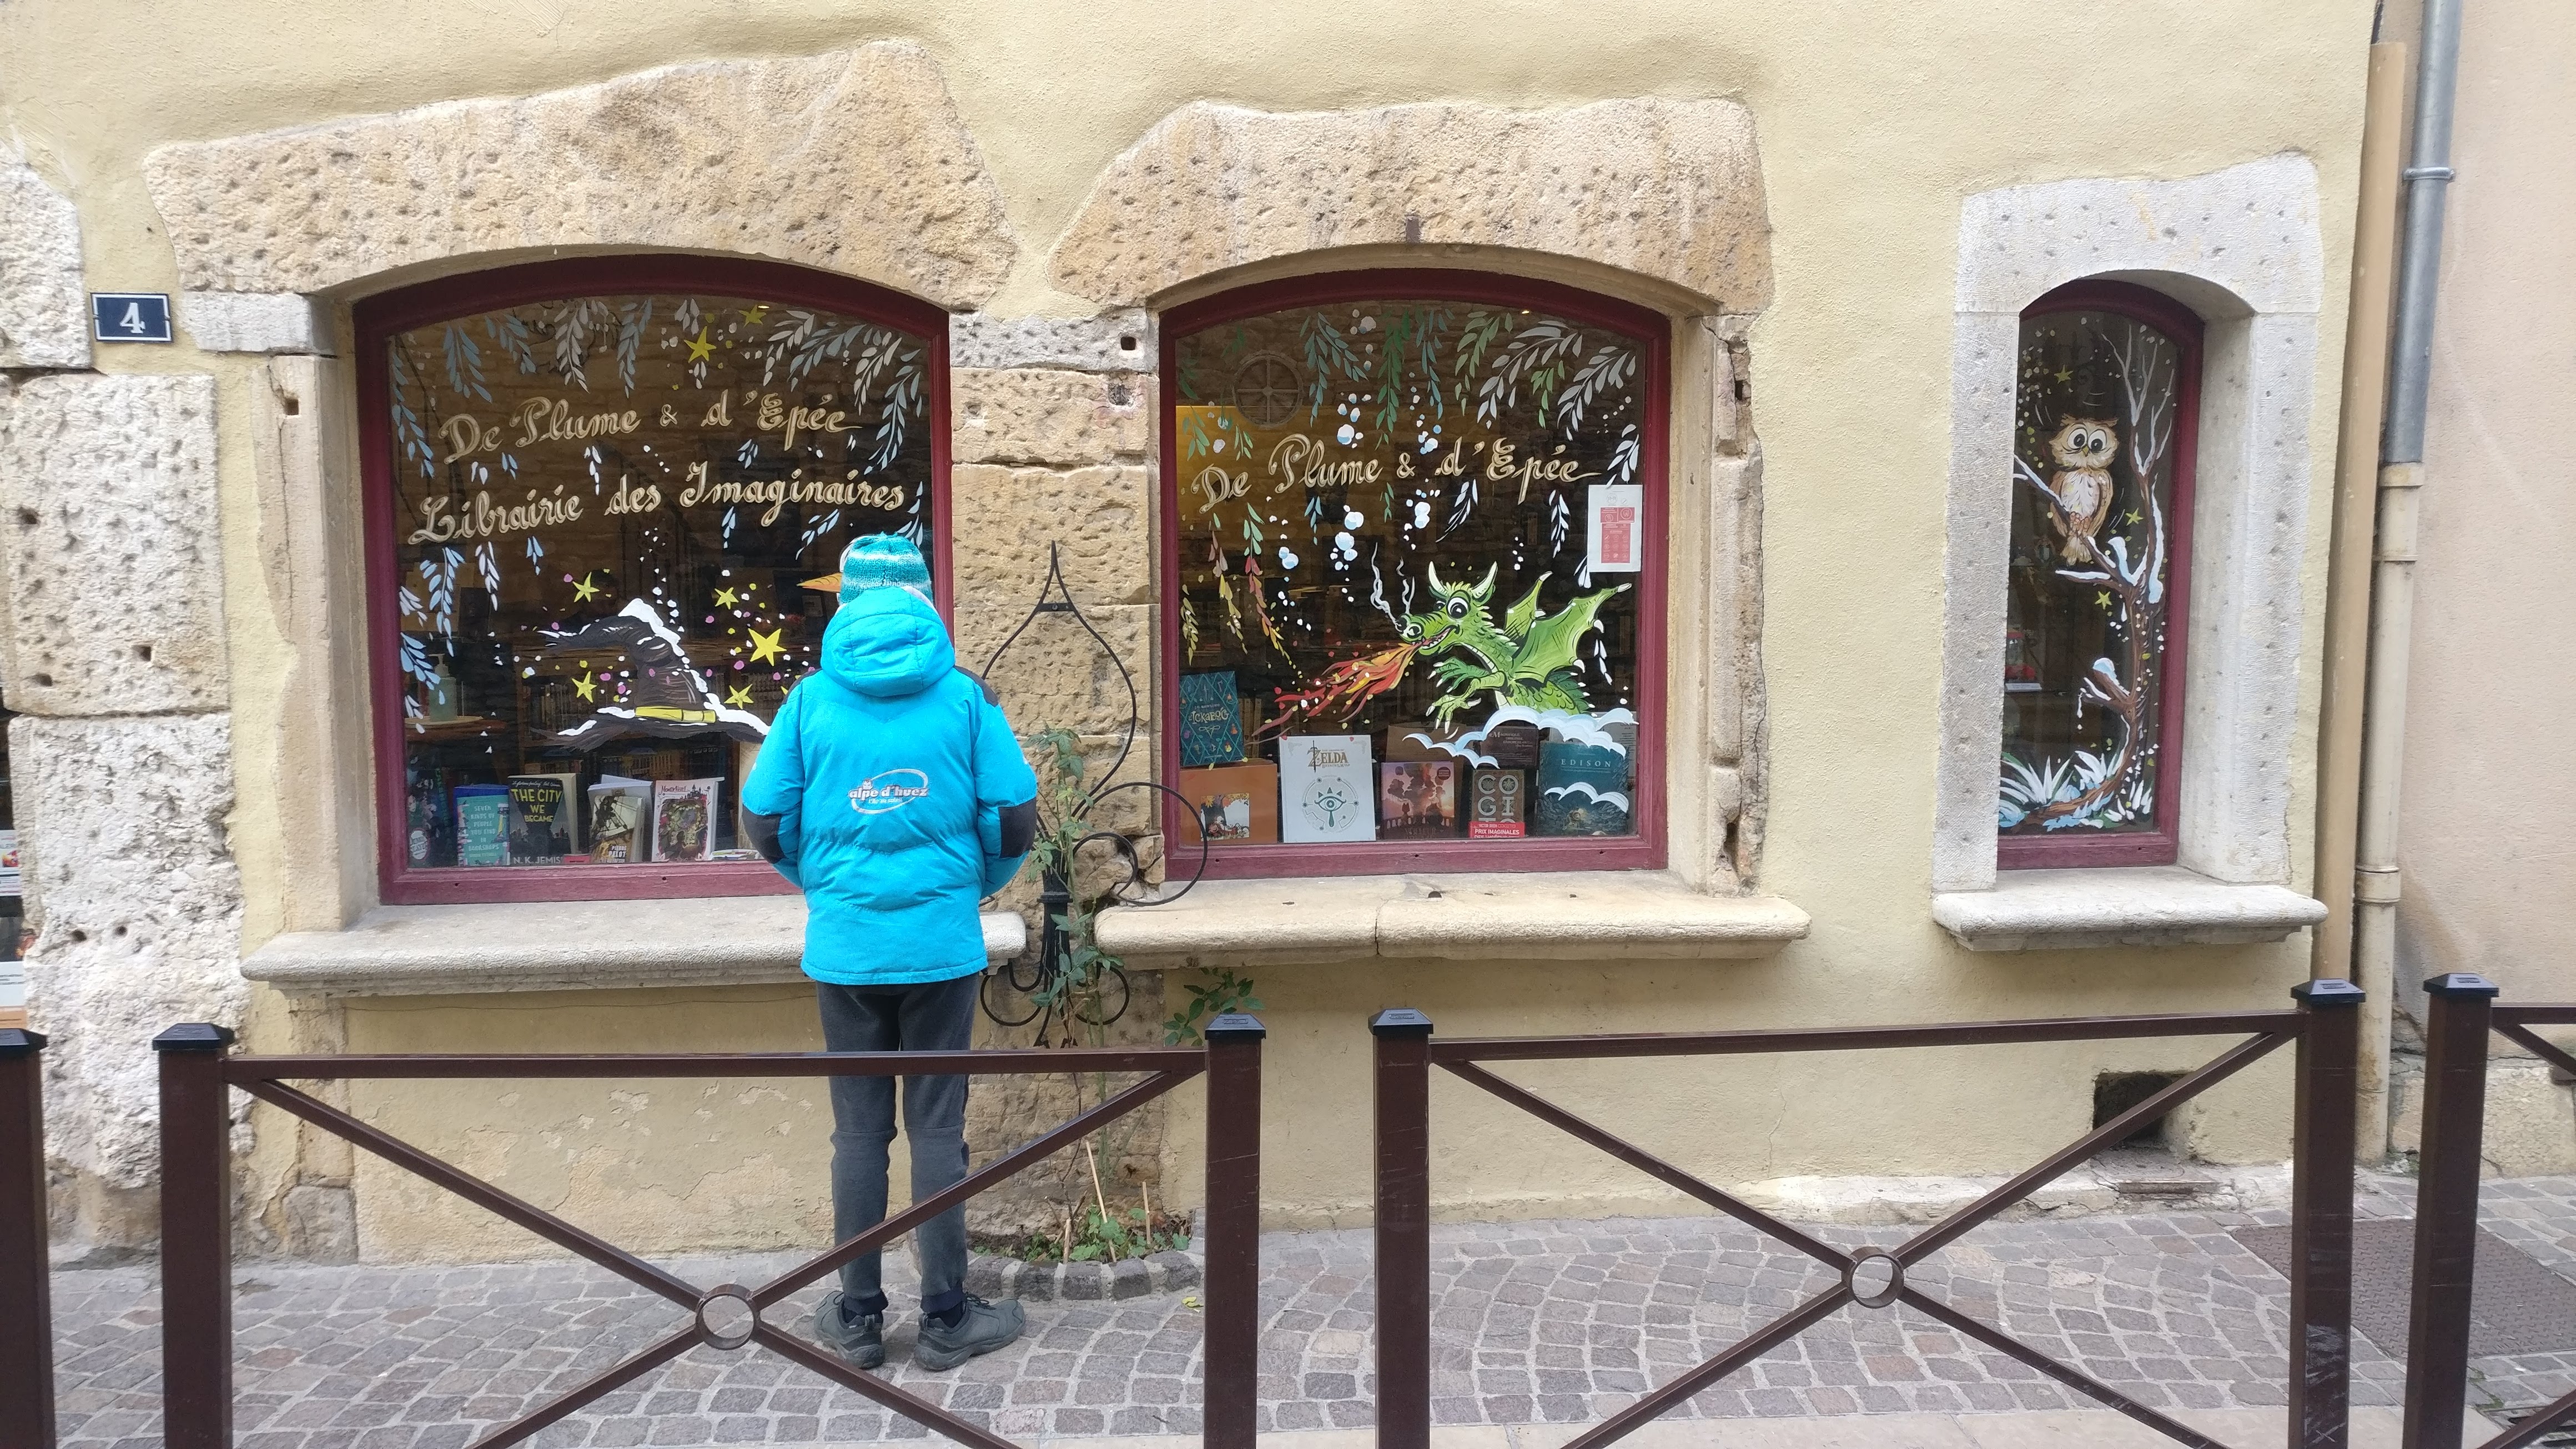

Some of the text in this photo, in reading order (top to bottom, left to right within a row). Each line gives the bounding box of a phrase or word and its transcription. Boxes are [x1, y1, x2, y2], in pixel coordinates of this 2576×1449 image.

[119, 302, 145, 333] 4
[439, 414, 502, 464] De
[510, 396, 641, 447] Plume
[660, 404, 678, 427] &
[1191, 464, 1252, 514] De
[1268, 434, 1383, 493] Plume
[1397, 452, 1416, 478] &
[408, 461, 904, 545] Librairie des Imaginaires
[1306, 749, 1349, 767] ZELDA
[511, 789, 562, 803] THE CITY
[849, 786, 878, 801] alpe
[881, 785, 929, 797] d'huez
[530, 804, 545, 813] WE
